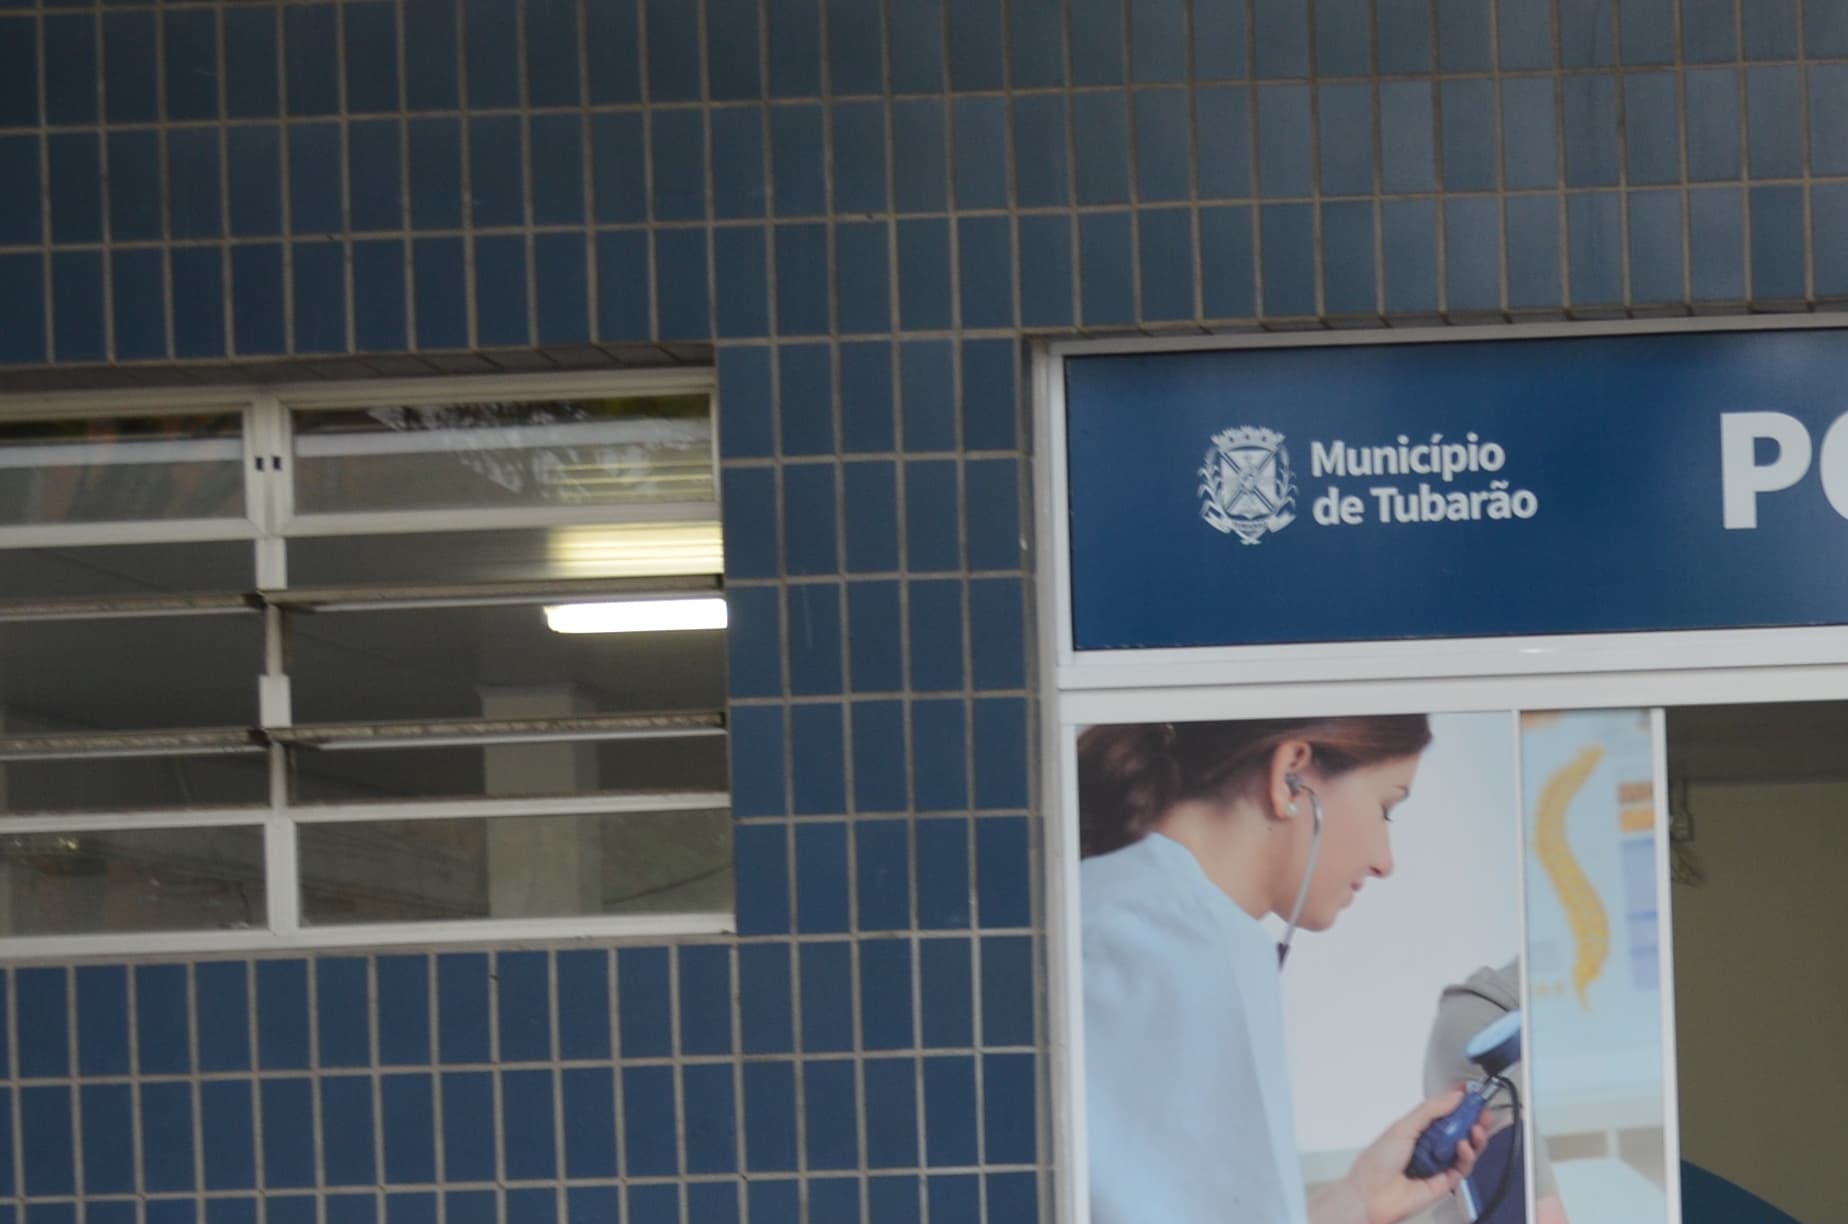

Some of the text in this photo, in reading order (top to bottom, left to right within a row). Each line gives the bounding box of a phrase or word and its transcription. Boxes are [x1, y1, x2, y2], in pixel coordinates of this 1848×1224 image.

[1310, 432, 1506, 482] Município
[1312, 480, 1539, 525] de Tubarão
